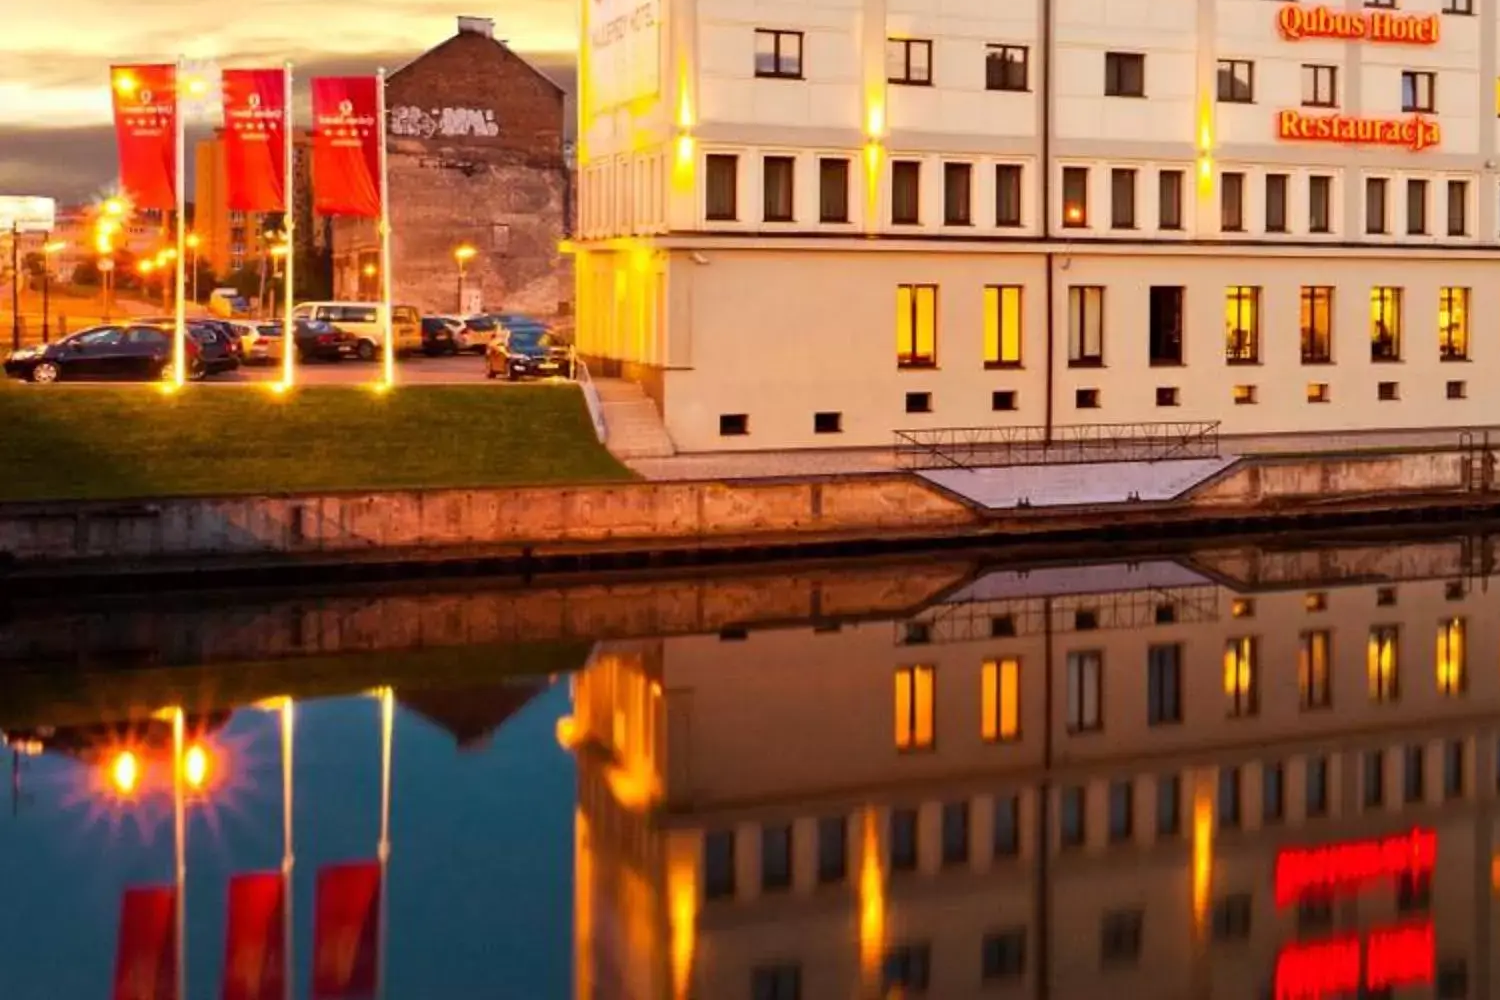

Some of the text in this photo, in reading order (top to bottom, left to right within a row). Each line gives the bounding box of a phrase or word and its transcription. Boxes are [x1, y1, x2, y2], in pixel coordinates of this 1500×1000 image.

[1279, 5, 1440, 43] Qubus Hotel
[1279, 110, 1440, 149] Restauracja
